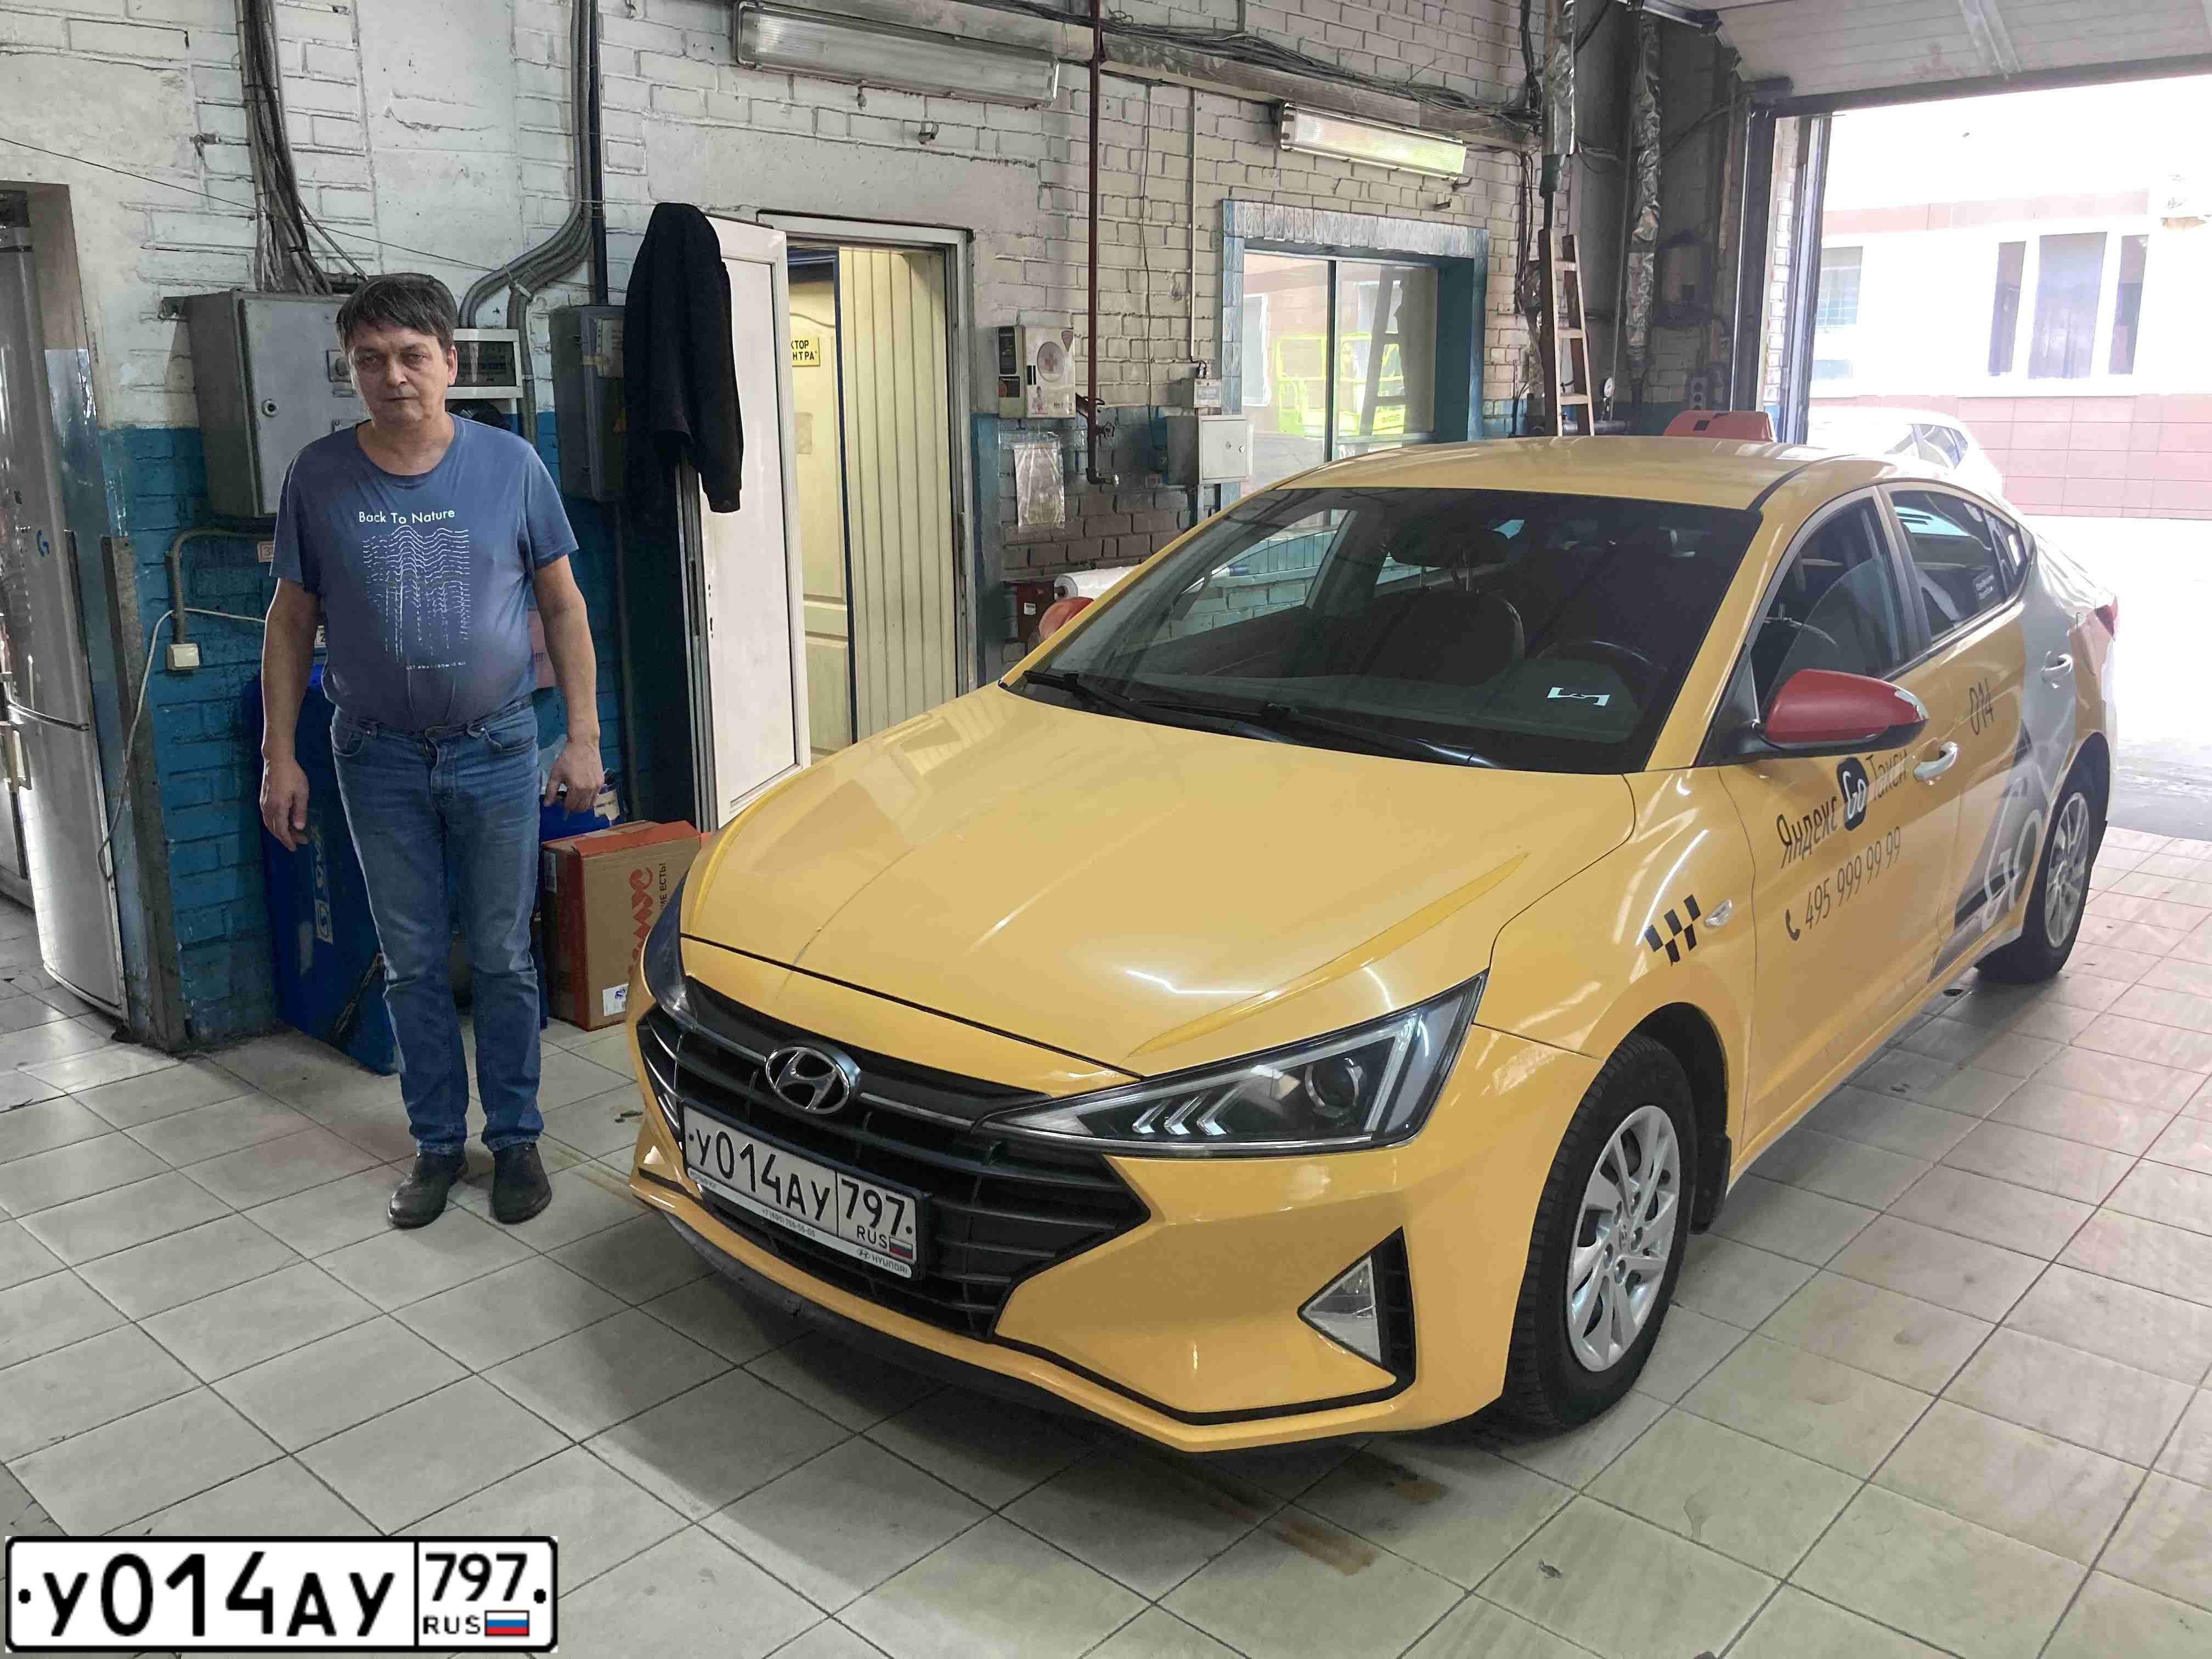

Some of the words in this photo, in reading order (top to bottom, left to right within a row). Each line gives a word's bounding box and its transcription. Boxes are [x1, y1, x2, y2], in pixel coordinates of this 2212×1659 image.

[359, 511, 386, 523] Back
[391, 512, 407, 524] To
[411, 510, 455, 524] Nature
[1969, 675, 1994, 736] 014
[1776, 795, 1837, 869] Яндекс
[1842, 770, 1866, 820] Go
[1866, 749, 1908, 802] Такси
[1805, 877, 1831, 930] 495
[1837, 855, 1862, 908] 999
[1866, 840, 1882, 885] 99
[1886, 826, 1901, 870] 99
[842, 1178, 905, 1237] 797
[857, 1224, 888, 1250] RUS
[871, 1253, 909, 1274] HYUNDAI
